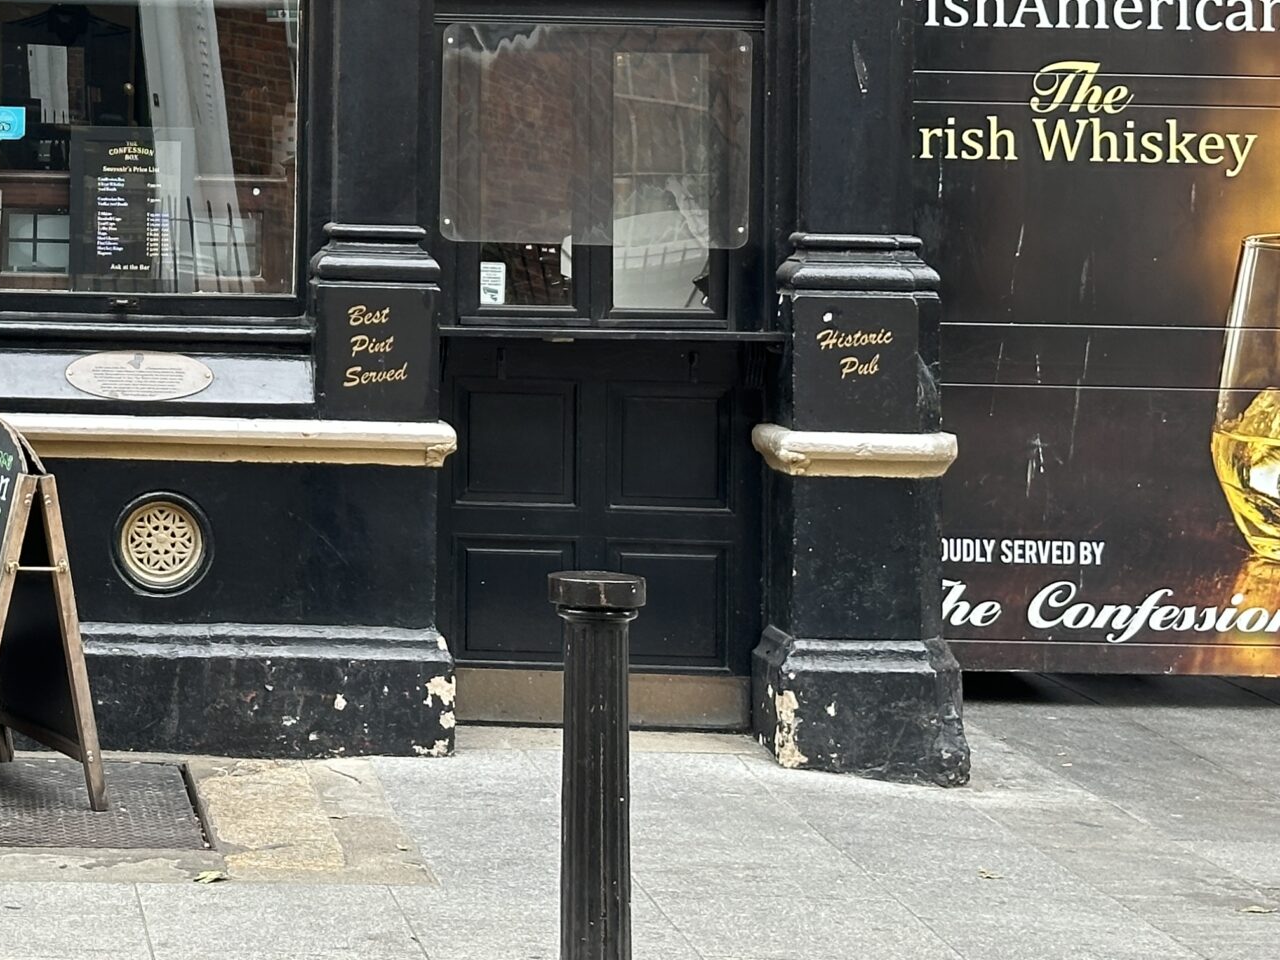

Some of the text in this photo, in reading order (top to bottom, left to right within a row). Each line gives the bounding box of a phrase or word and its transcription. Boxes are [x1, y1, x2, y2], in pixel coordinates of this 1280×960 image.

[1030, 60, 1135, 114] The
[108, 147, 154, 157] CONFESSION
[912, 116, 1258, 177] rish Whiskey
[347, 304, 390, 326] Best
[350, 334, 394, 357] Pint
[816, 328, 894, 350] Historic
[343, 361, 408, 387] Served
[839, 353, 880, 379] Pub
[1000, 539, 1075, 564] SERVED
[1079, 541, 1105, 565] BY
